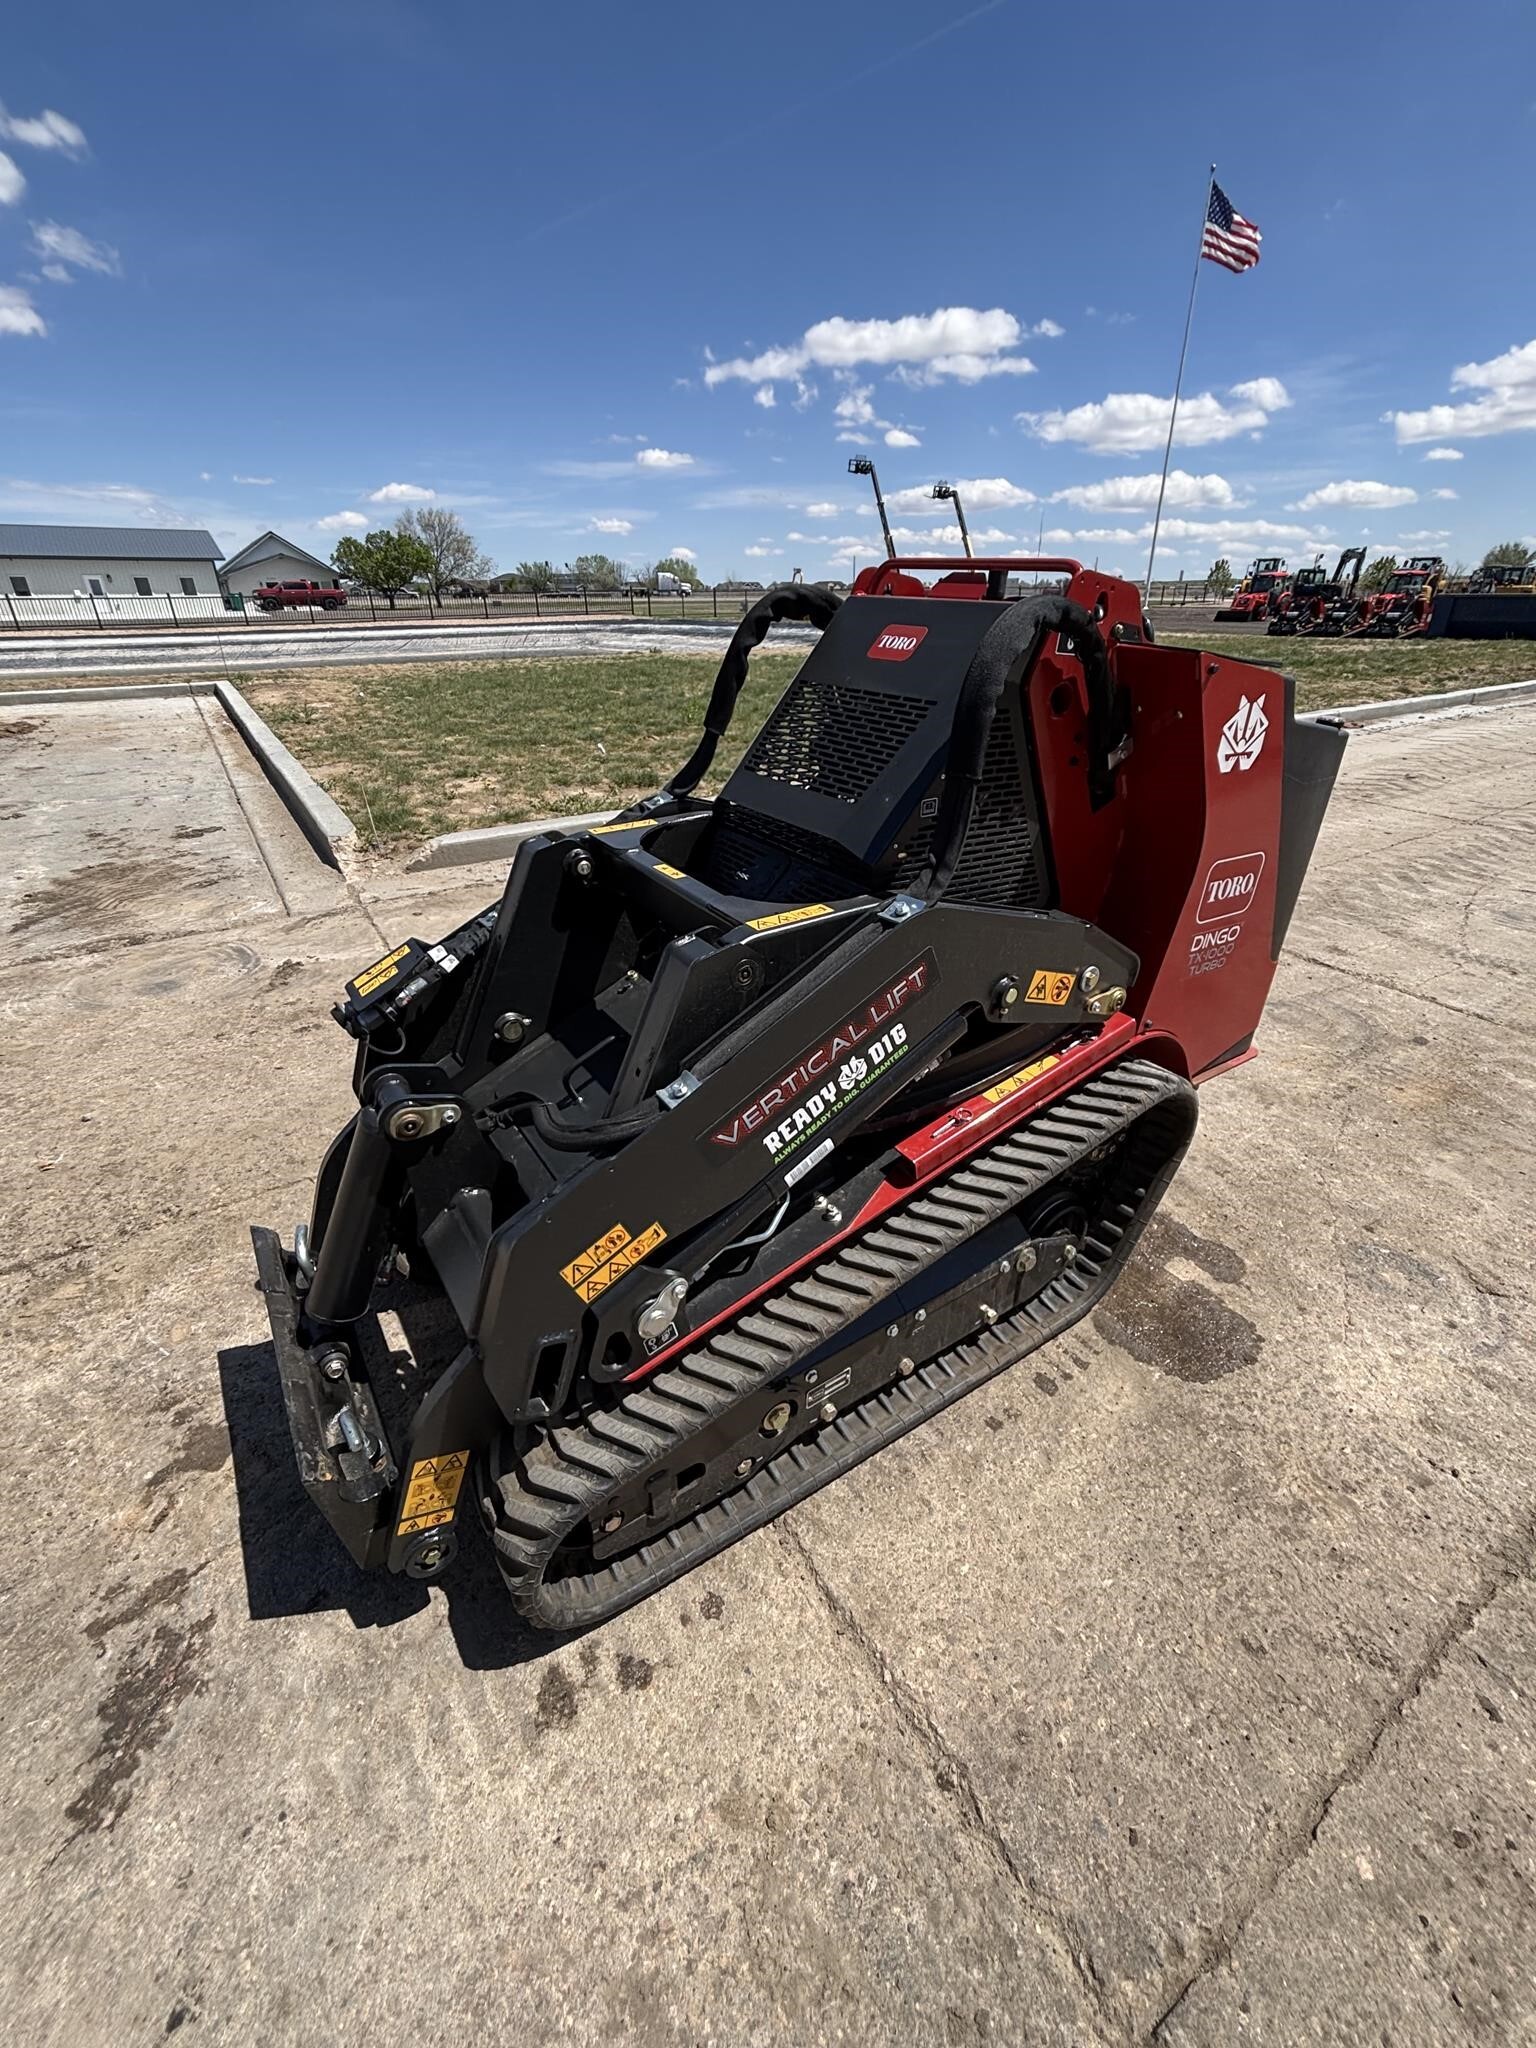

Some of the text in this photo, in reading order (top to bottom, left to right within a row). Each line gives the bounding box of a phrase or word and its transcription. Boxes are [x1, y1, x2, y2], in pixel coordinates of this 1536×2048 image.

[878, 635, 917, 650] TORO
[1207, 873, 1254, 903] TORO
[1191, 925, 1240, 952] DINGO
[1190, 957, 1226, 976] TURBO
[716, 965, 924, 1144] VERTICAL LIFT
[763, 1023, 907, 1155] READY DIG
[774, 1134, 806, 1164] ALWAYS
[805, 1110, 832, 1136] READY
[832, 1101, 844, 1112] TO
[860, 1044, 909, 1089] GUARANTEED
